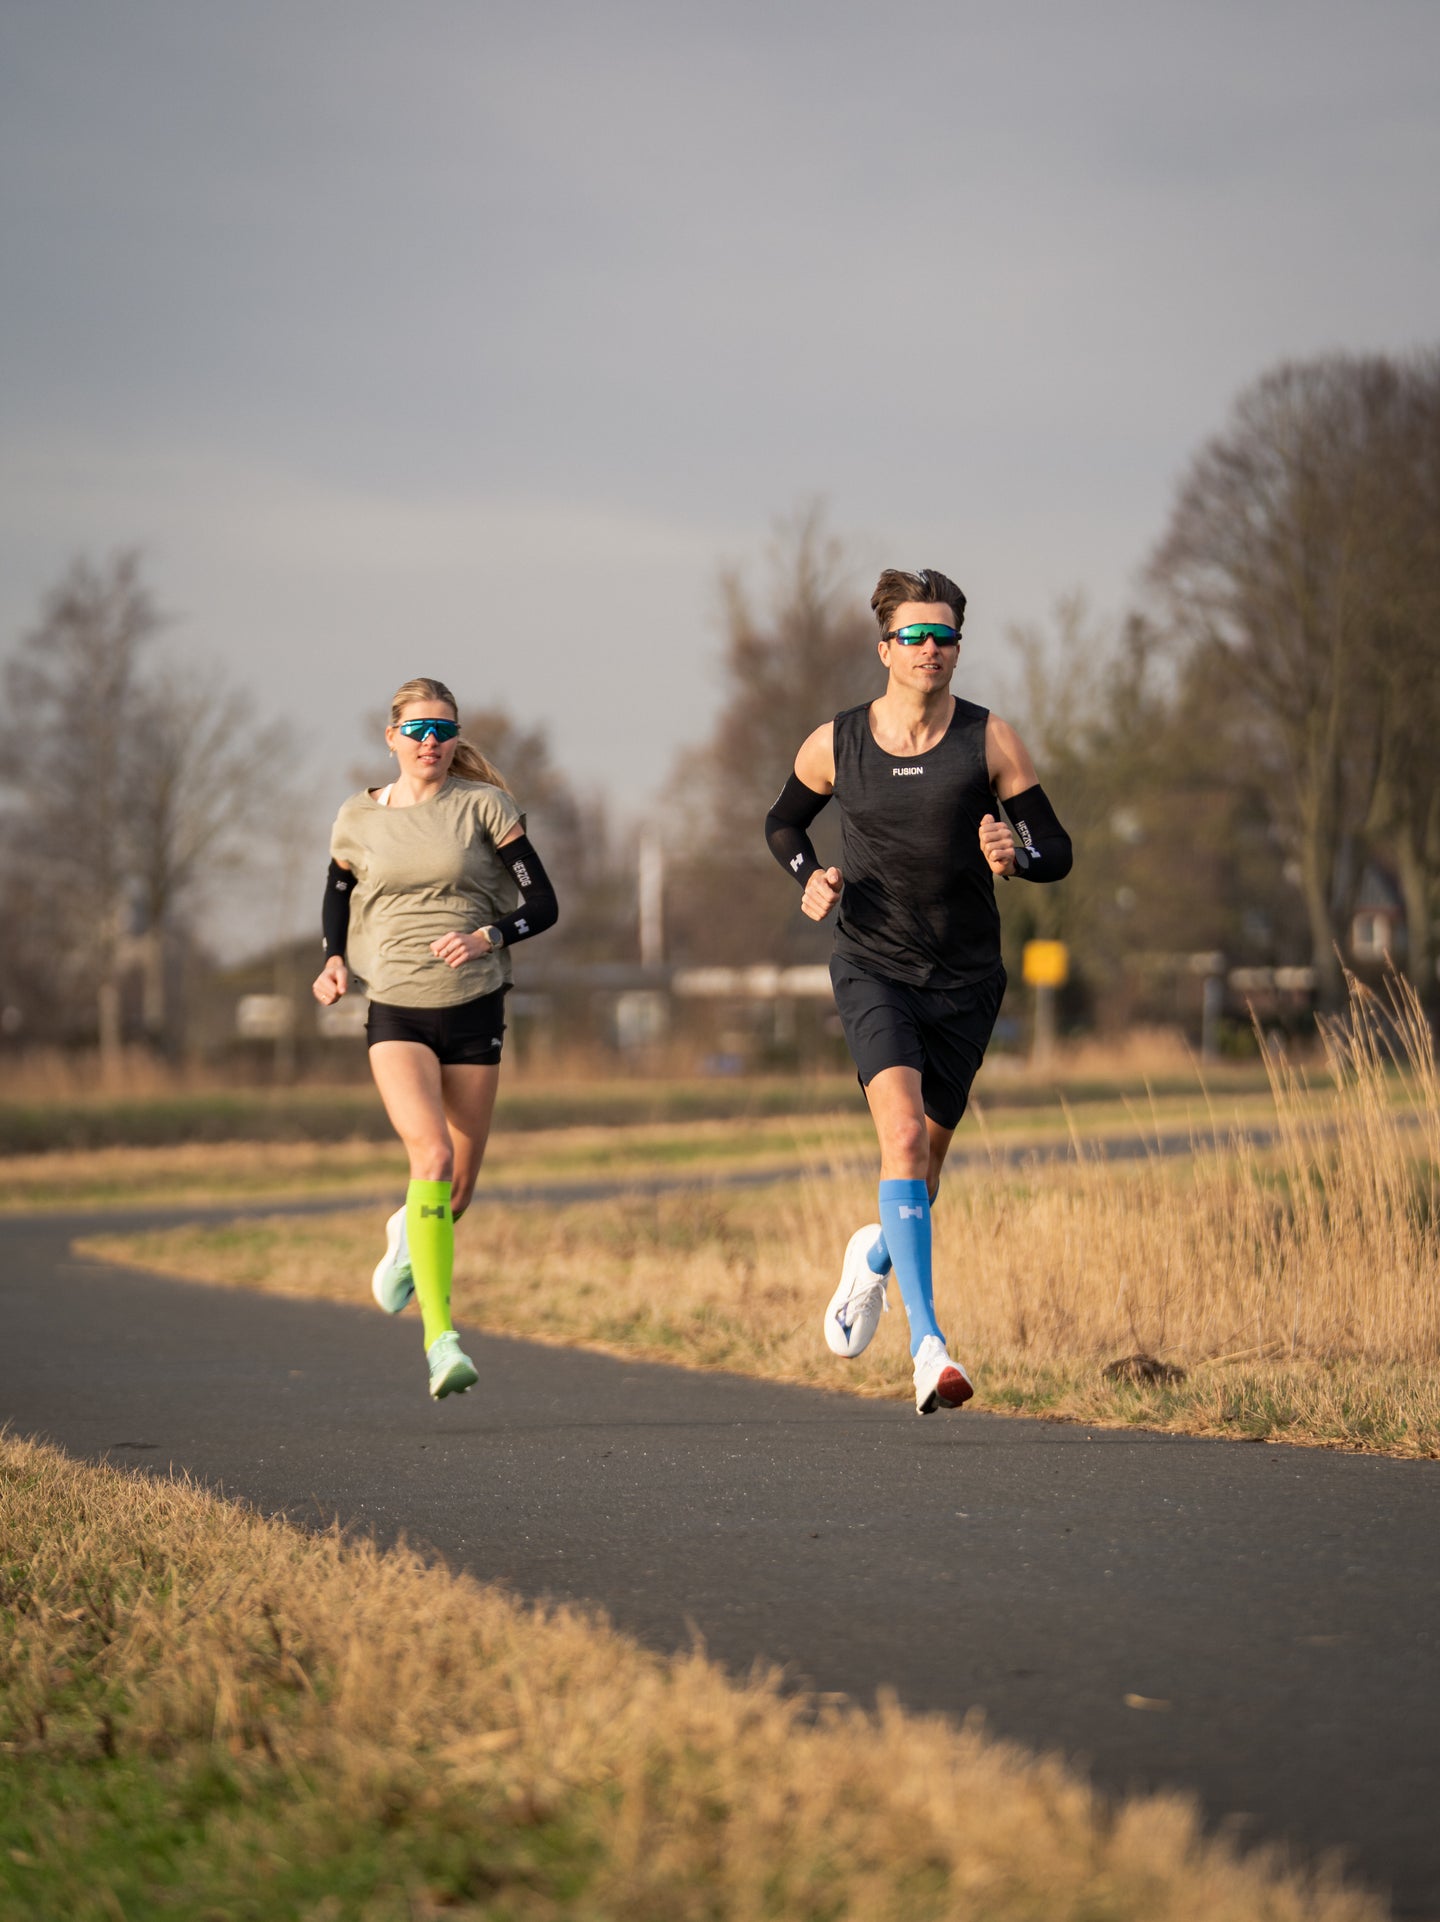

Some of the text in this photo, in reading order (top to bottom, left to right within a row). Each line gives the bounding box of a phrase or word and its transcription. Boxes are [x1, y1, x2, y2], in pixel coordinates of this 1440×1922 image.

[892, 766, 923, 776] FUSION
[512, 859, 532, 887] HERZOG
[514, 918, 530, 934] H
[421, 1205, 445, 1219] H
[898, 1205, 923, 1219] H
